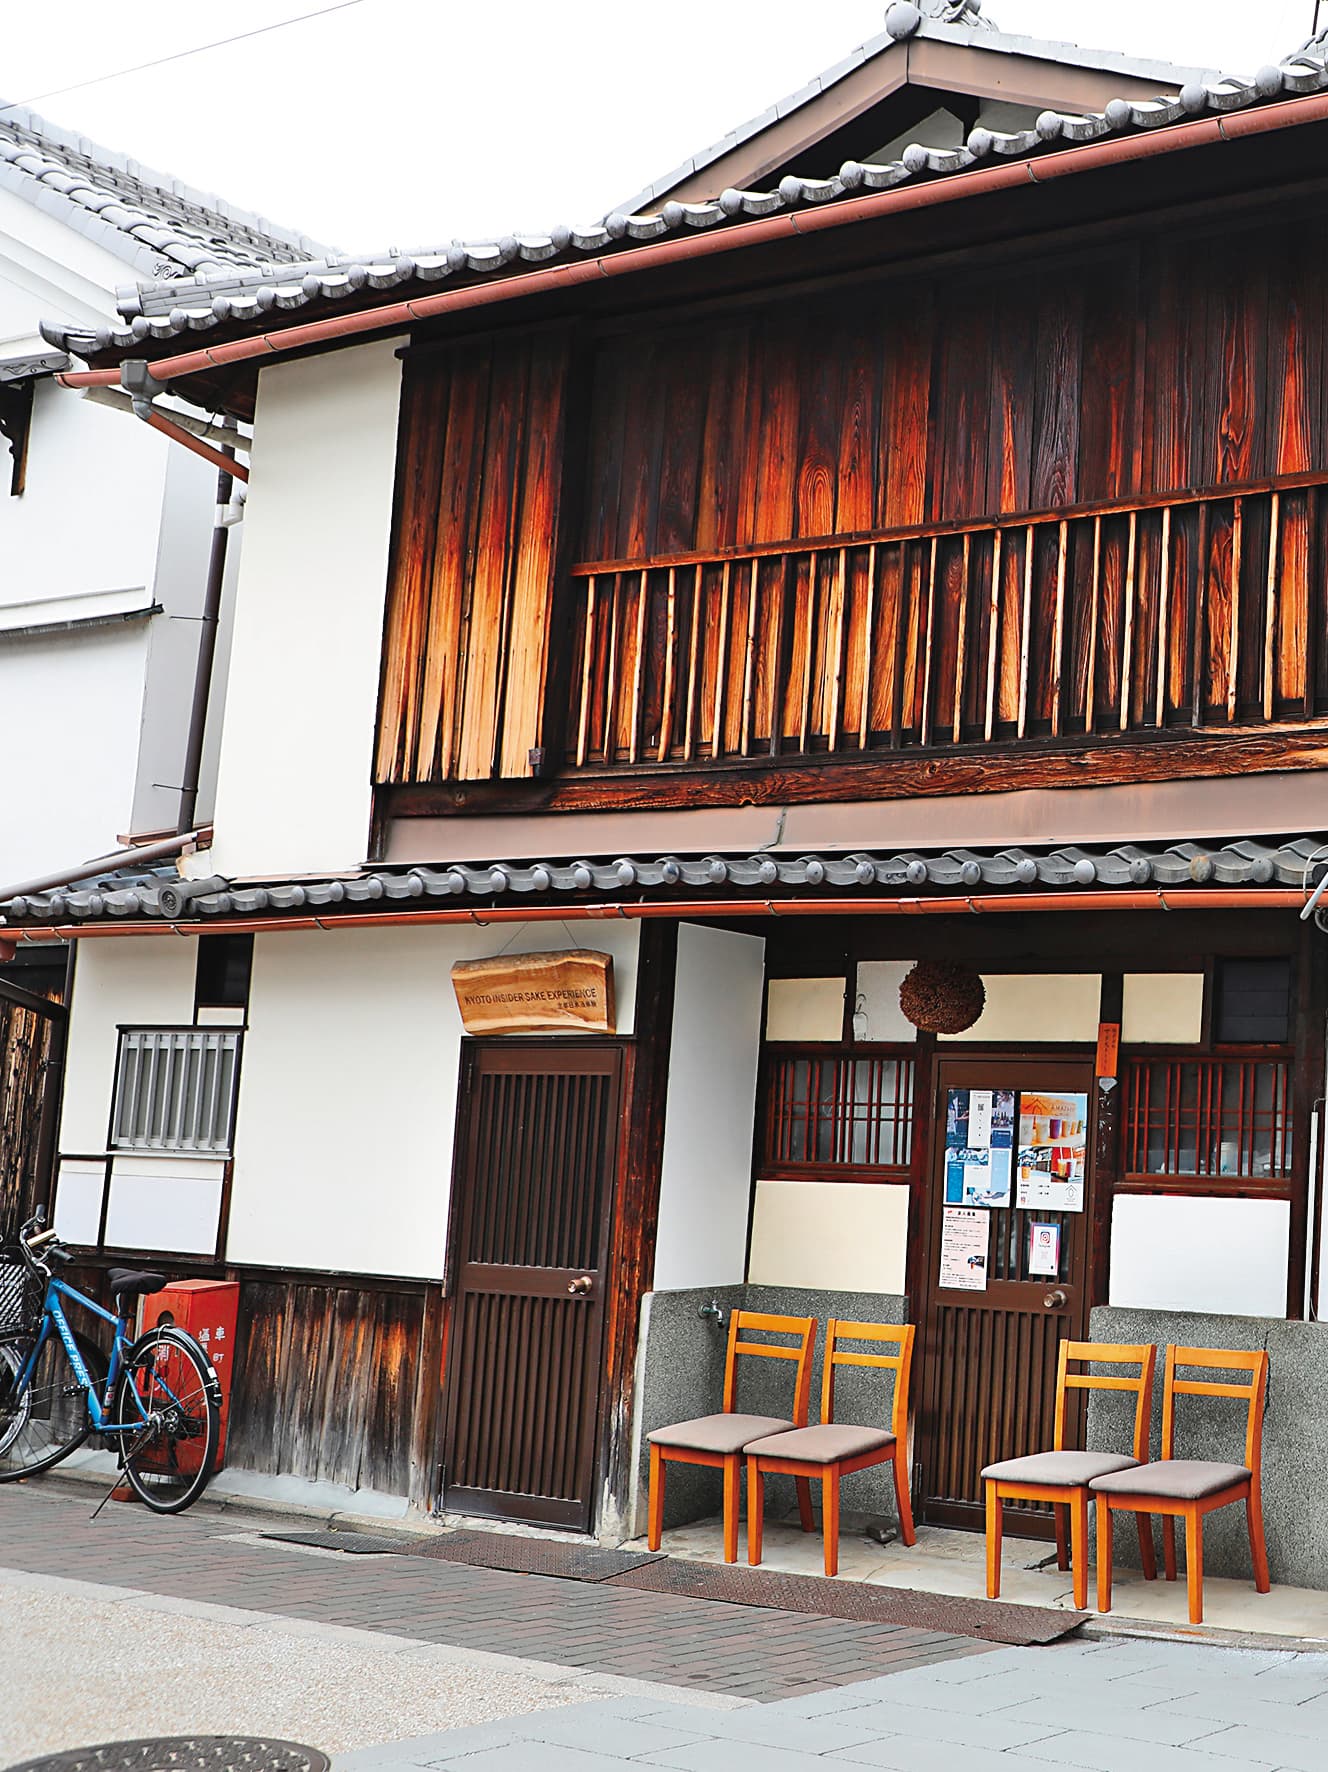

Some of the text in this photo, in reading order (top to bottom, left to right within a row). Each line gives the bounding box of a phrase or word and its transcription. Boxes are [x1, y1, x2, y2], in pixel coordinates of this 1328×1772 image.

[464, 988, 597, 1005] KYOTO INSIDER SAKE EXPERIENCE
[52, 1310, 75, 1353] OFFICE
